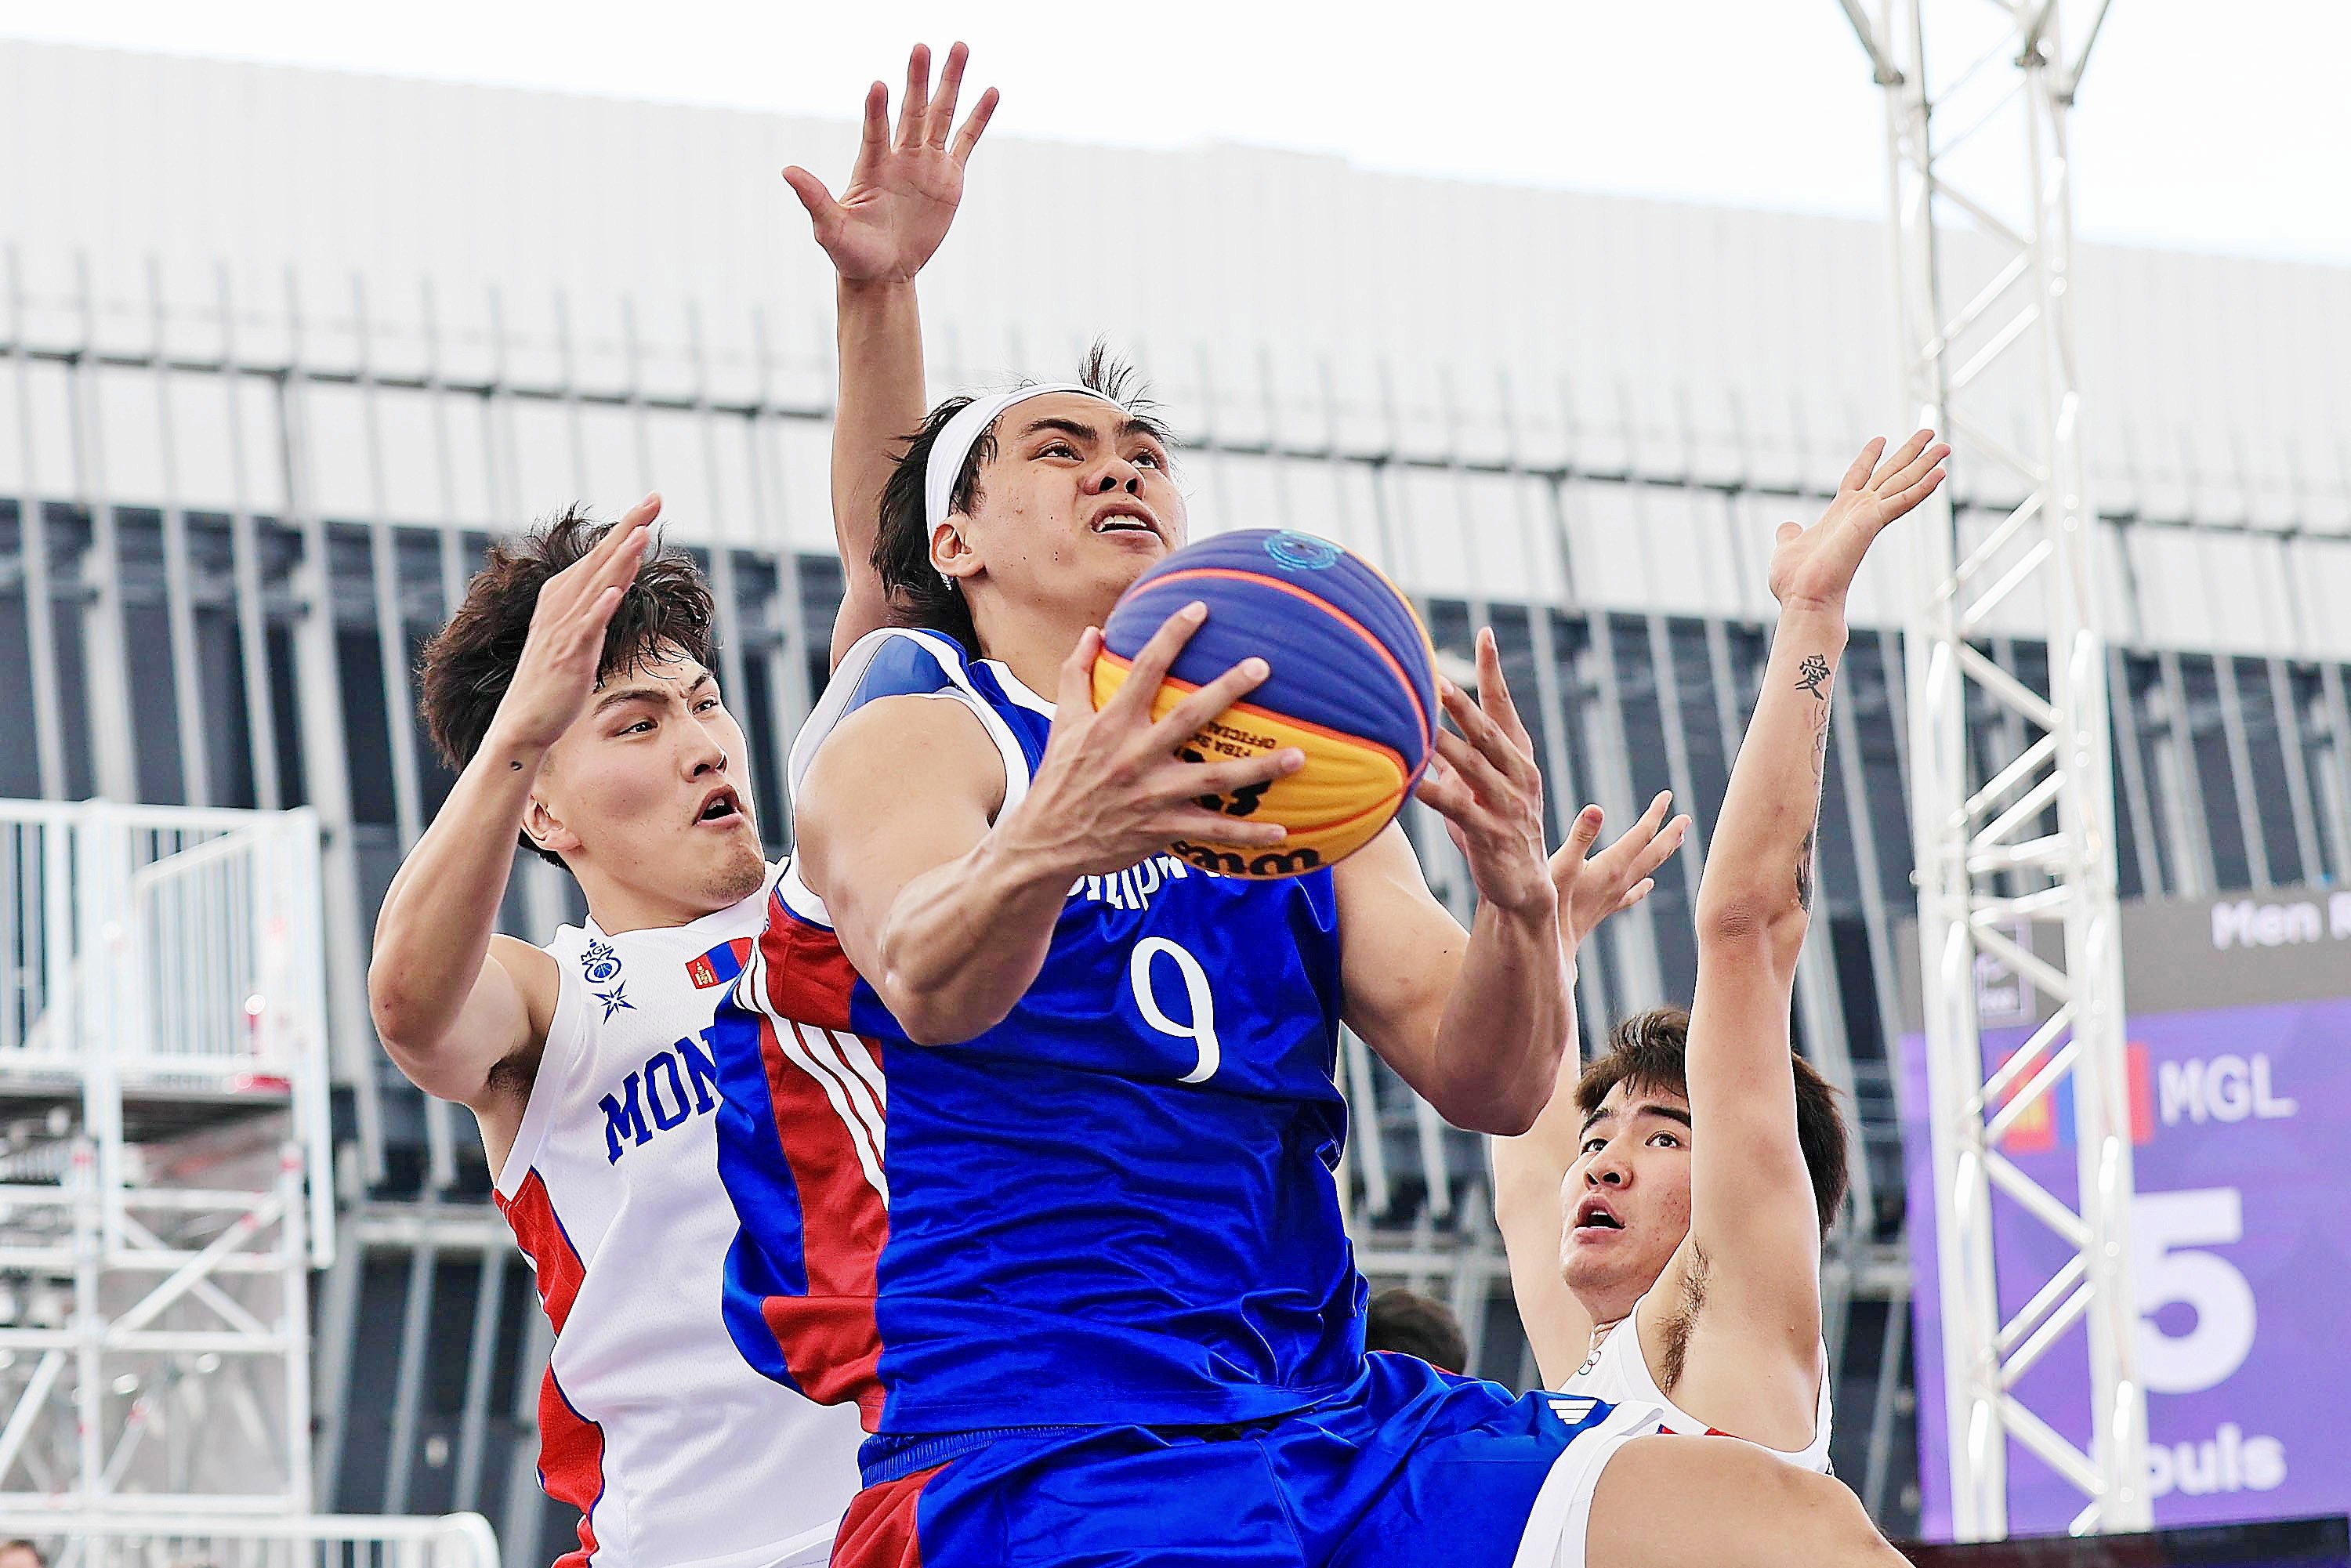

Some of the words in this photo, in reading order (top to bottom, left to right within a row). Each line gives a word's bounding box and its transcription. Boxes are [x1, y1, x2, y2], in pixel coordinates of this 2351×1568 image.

[580, 943, 612, 961] MGL
[2211, 900, 2322, 950] Men
[1130, 936, 1220, 1083] 9
[597, 1025, 719, 1167] MON
[2157, 1055, 2298, 1127] MGL
[2132, 1186, 2259, 1395] 5
[2141, 1421, 2288, 1499] ouls
